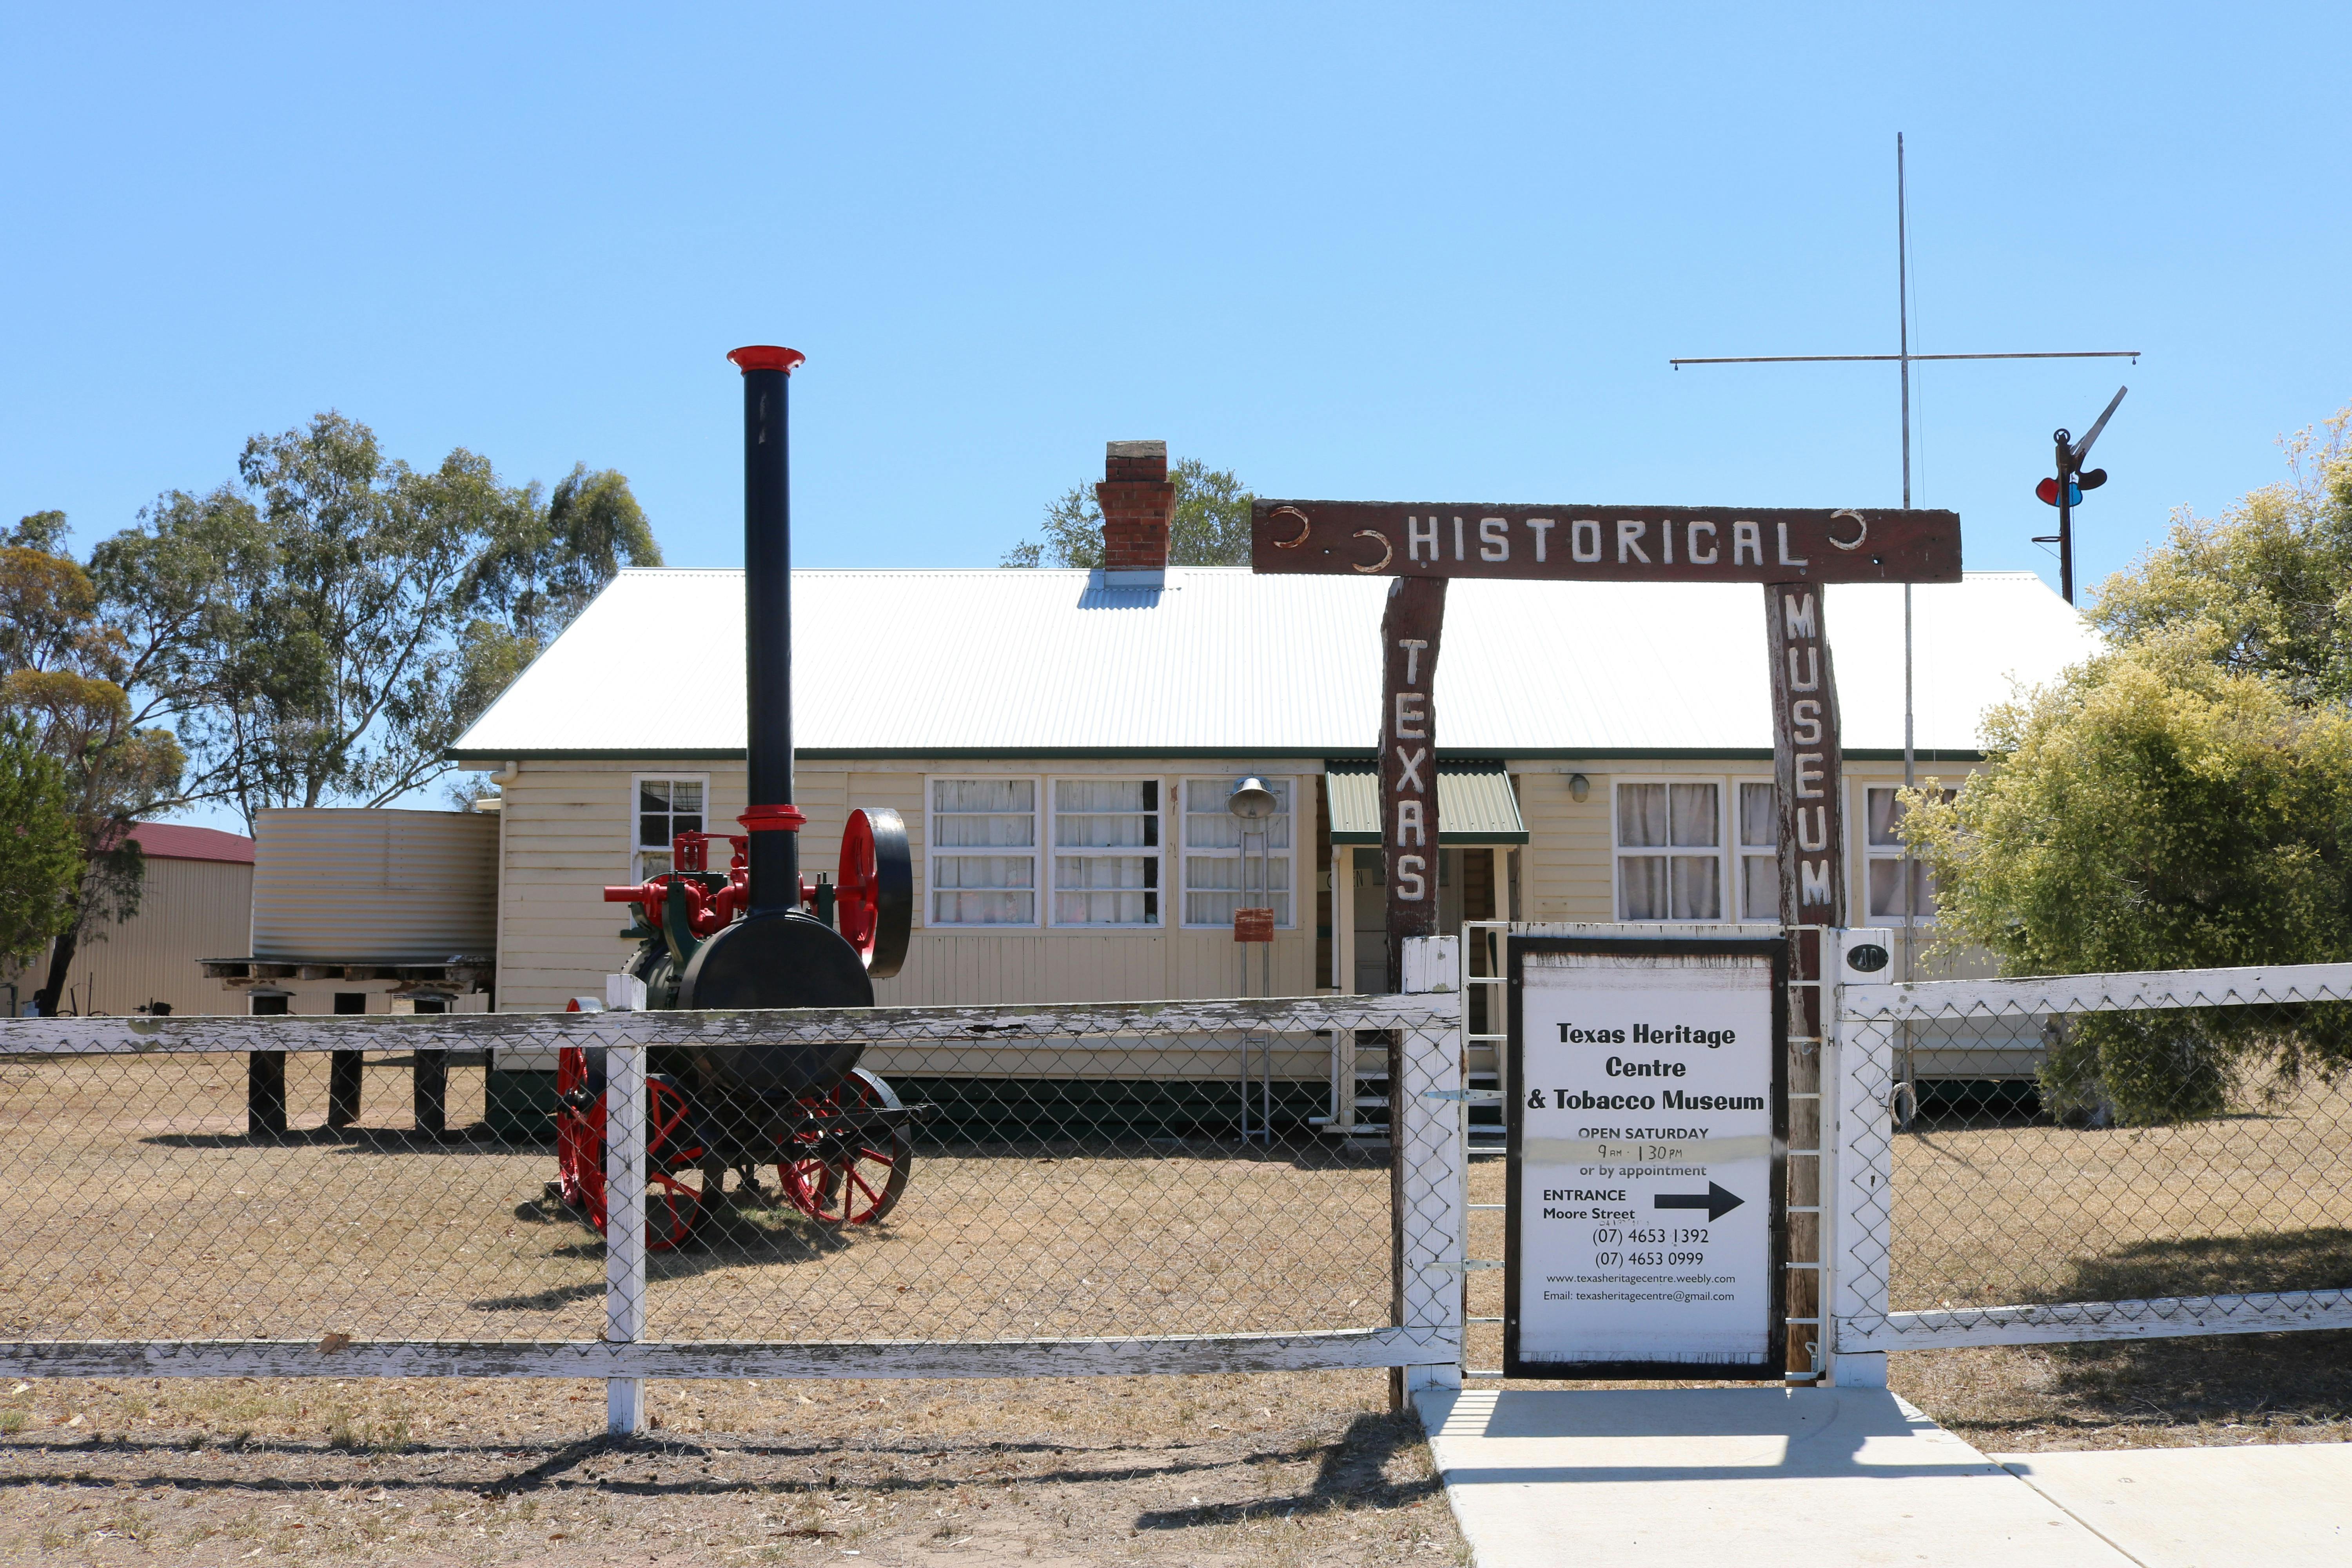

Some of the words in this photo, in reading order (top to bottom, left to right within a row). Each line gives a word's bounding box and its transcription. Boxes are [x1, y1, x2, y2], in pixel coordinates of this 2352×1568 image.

[1408, 516, 1809, 566] HISTORICAL
[1785, 593, 1830, 907] MUSEUM
[1396, 639, 1429, 901] TEXAS
[1857, 947, 1878, 968] 40
[1556, 1023, 1625, 1044] Texas
[1633, 1024, 1735, 1049] Heritage
[1606, 1056, 1686, 1077] Centre
[1527, 1089, 1546, 1109] &
[1553, 1089, 1655, 1110] Tobacco
[1663, 1090, 1764, 1110] Museum
[1578, 1127, 1620, 1139] OPEN
[1625, 1127, 1709, 1139] SATURDAY
[1599, 1164, 1615, 1179] by
[1619, 1165, 1707, 1179] appointment
[1543, 1189, 1626, 1201] ENTRANCE
[1543, 1208, 1588, 1219] Moore
[1592, 1208, 1635, 1219] Street
[1593, 1229, 1623, 1247] (07)
[1628, 1229, 1665, 1243] 4653
[1673, 1229, 1709, 1243] 1392
[1595, 1252, 1623, 1269] (07)
[1628, 1252, 1663, 1265] 4653
[1668, 1252, 1703, 1265] 0999
[1546, 1273, 1736, 1285] www.texasheritagecentre.weebly.com
[1544, 1290, 1573, 1300] Email:
[1576, 1290, 1735, 1303] texasheritagecentre@gmail.com
